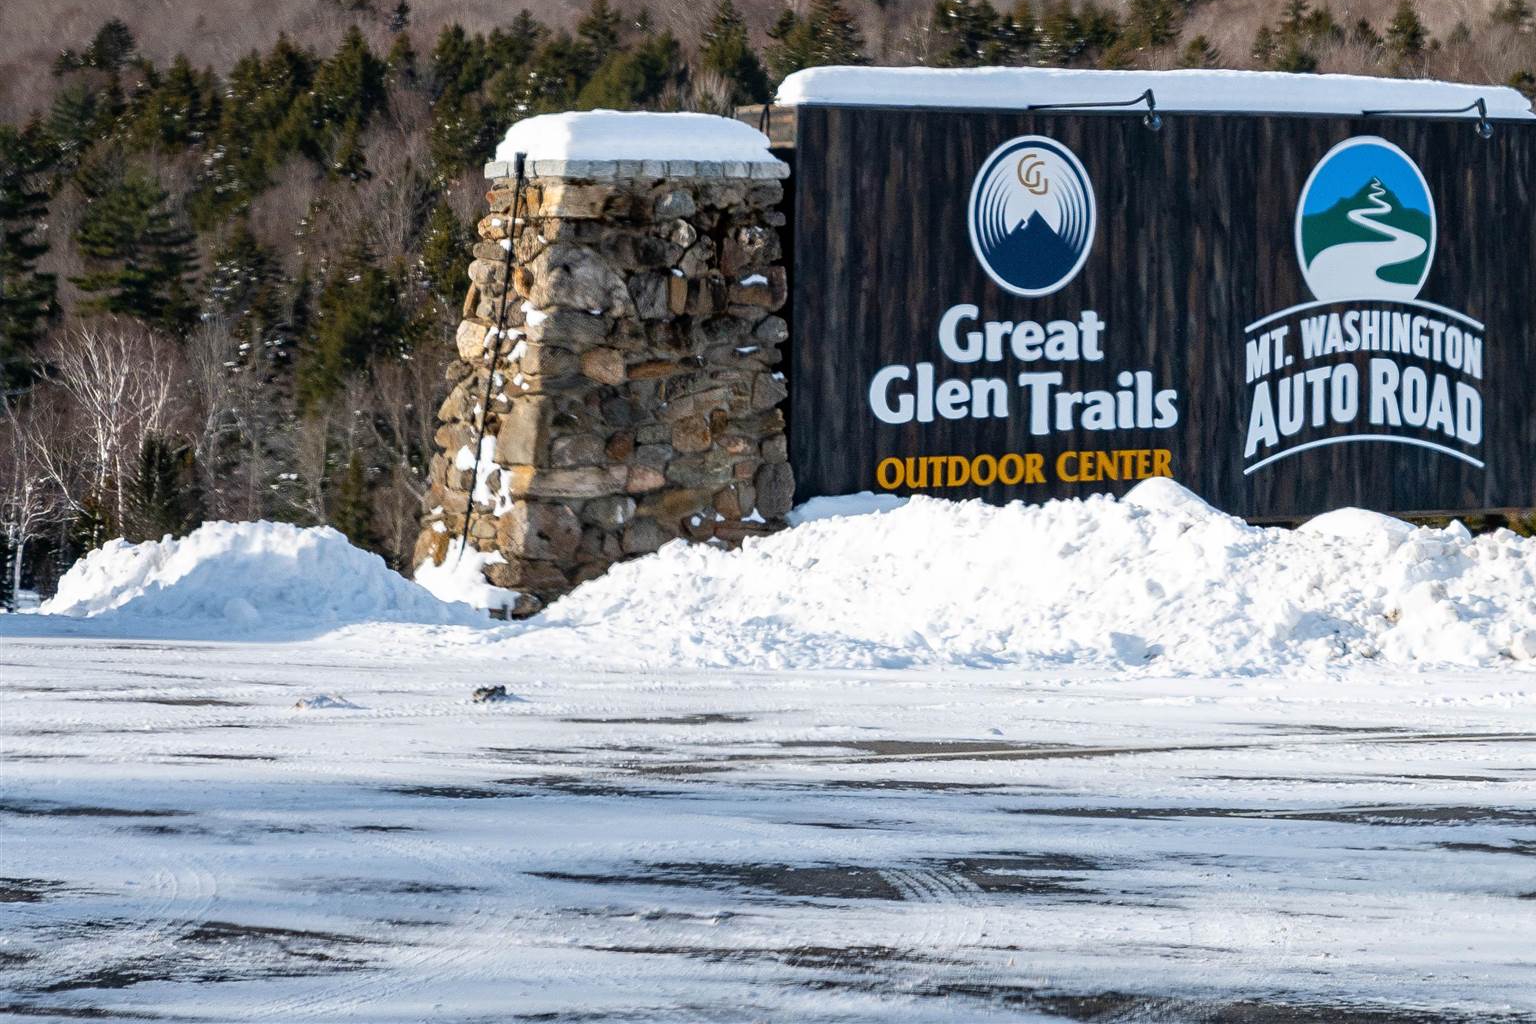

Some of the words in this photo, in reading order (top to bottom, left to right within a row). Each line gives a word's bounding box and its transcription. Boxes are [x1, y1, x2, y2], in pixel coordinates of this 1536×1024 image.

[938, 303, 1106, 364] Great
[1245, 325, 1294, 384] MT.
[1300, 310, 1484, 380] WASHINGTON
[868, 362, 1009, 424] Glen
[1018, 370, 1179, 436] Trails
[1243, 362, 1360, 459] AUTO
[1369, 357, 1483, 446] ROAD
[875, 452, 1047, 490] OUTDOOR
[1055, 448, 1175, 484] CENTER
